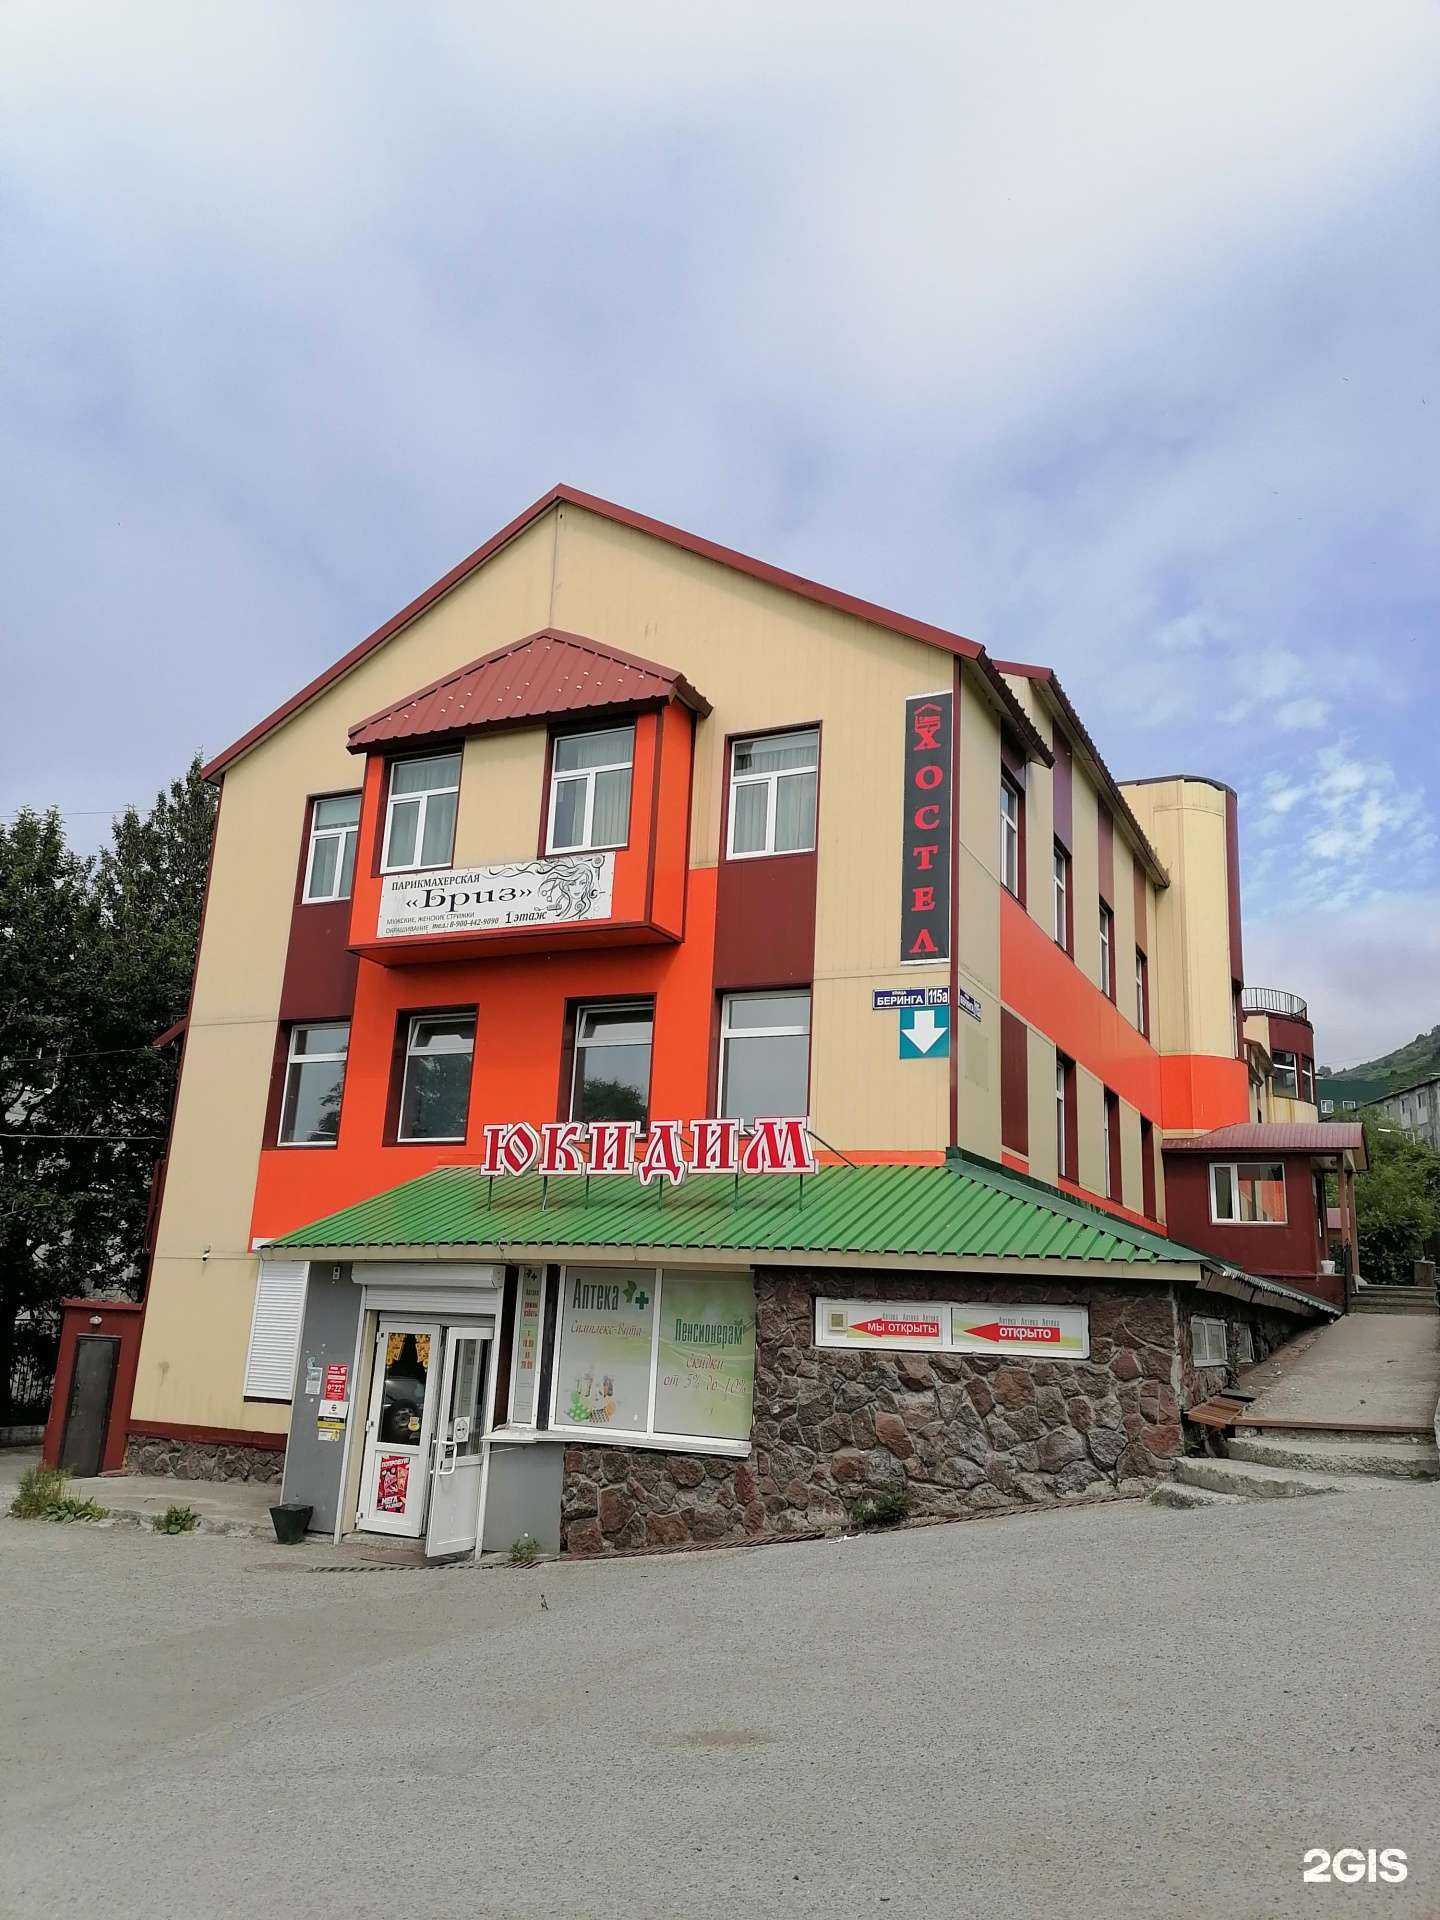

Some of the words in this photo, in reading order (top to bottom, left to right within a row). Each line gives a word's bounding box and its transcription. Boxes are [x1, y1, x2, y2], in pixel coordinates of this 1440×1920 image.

[911, 728, 943, 953] ХОСТЕЛ
[391, 874, 480, 891] ПАРИКМАХЕРСКАЯ
[406, 887, 532, 912] «Бриз»
[505, 912, 512, 924] 1
[513, 911, 548, 922] этаж
[877, 995, 924, 1006] БЕРИНГА
[572, 1278, 620, 1311] Аптека
[675, 1318, 744, 1350] Пенсионерам
